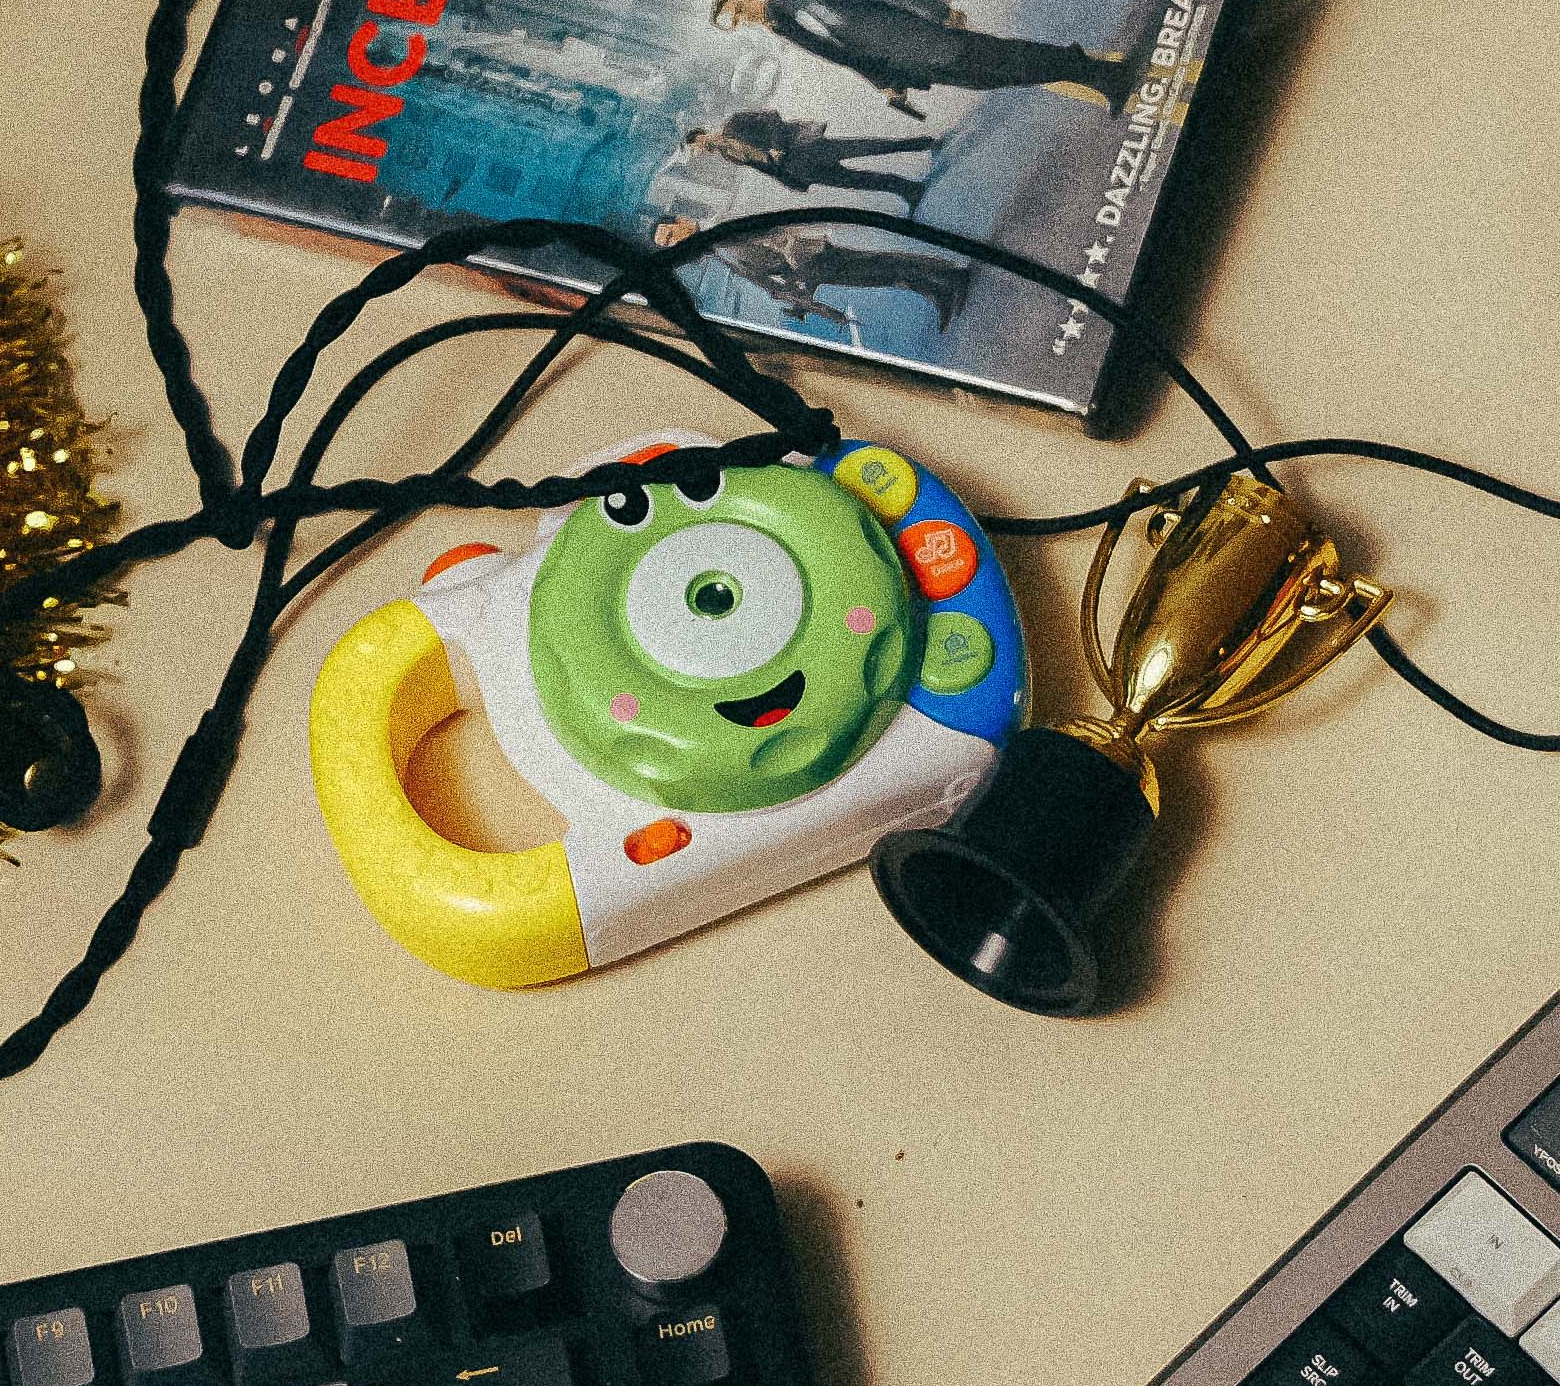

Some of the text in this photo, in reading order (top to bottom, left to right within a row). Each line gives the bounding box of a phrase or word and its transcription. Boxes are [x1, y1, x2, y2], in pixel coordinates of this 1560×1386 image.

[489, 1225, 525, 1248] Del
[1380, 1294, 1401, 1315] IN
[1385, 1276, 1421, 1310] TRIM
[657, 1313, 717, 1339] Home
[1308, 1351, 1342, 1383] SLIP
[1461, 1345, 1498, 1379] TRIM
